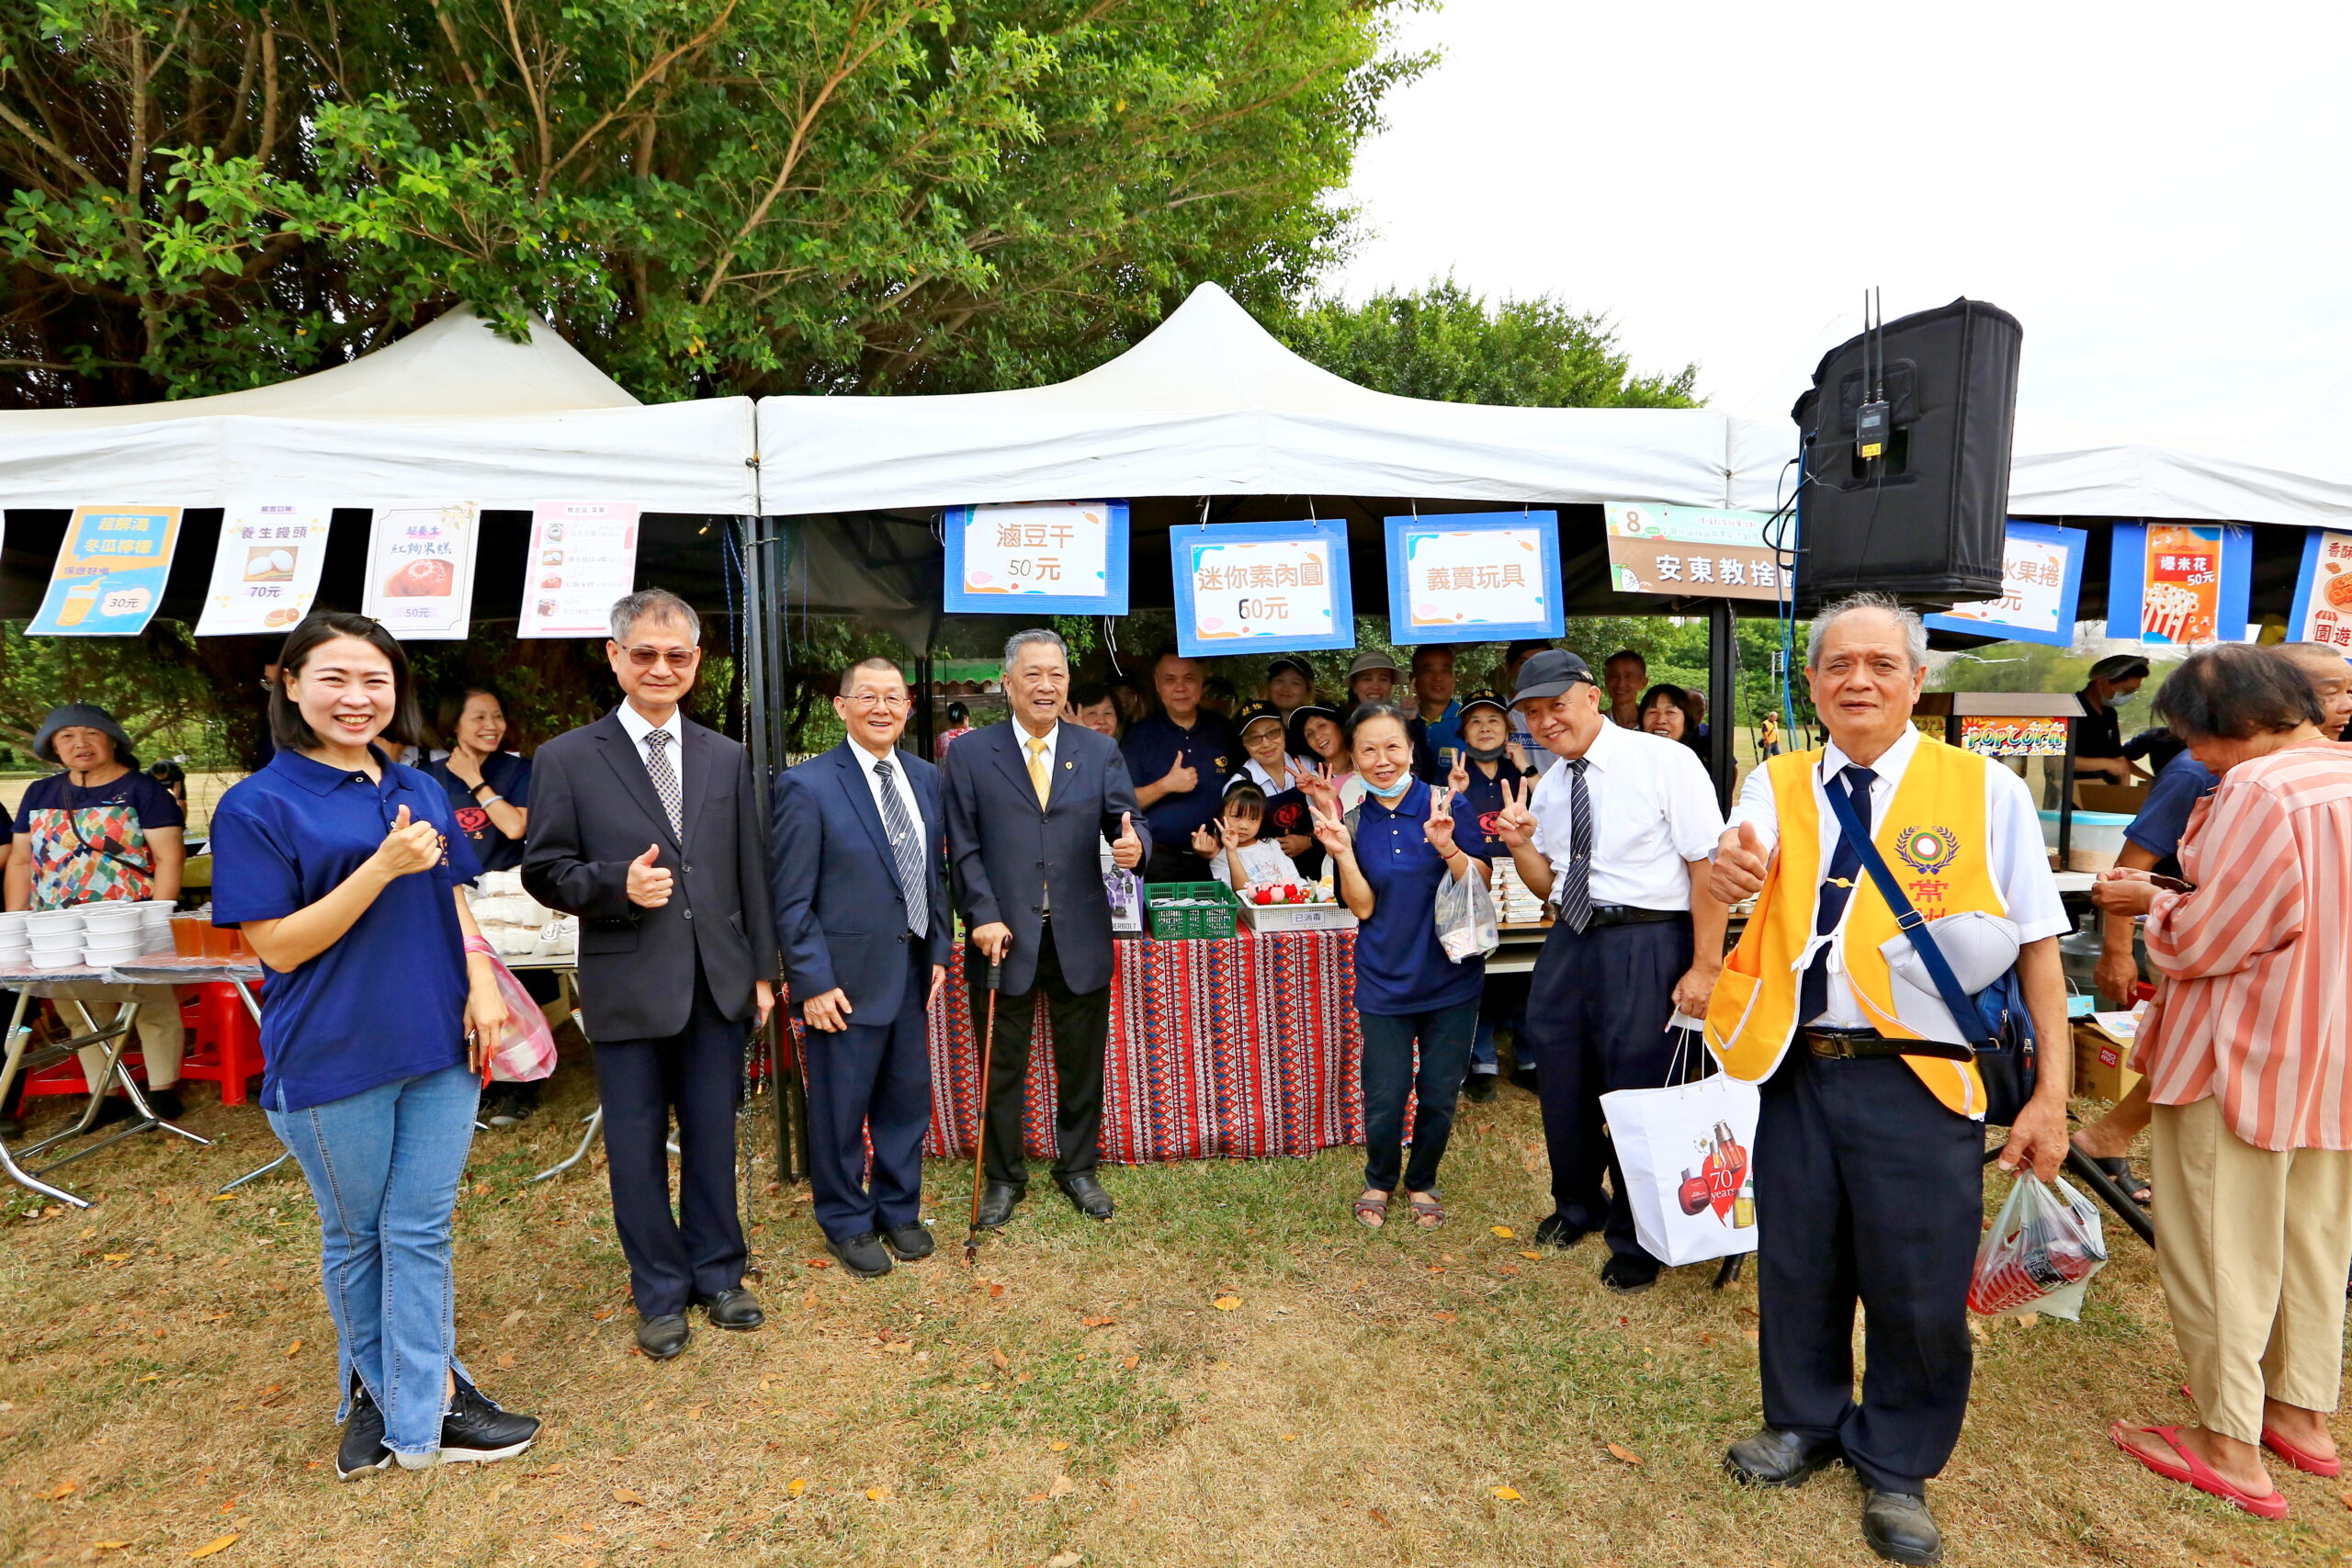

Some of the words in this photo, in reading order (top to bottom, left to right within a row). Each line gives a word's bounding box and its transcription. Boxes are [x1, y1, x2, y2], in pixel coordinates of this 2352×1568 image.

[1626, 511, 1641, 533] 8
[242, 526, 308, 539] 養生饅頭
[997, 523, 1074, 548] 滷豆干
[84, 539, 153, 554] 冬瓜檸檬
[1008, 558, 1061, 581] 50元
[2160, 555, 2207, 571] 爆米花
[1198, 563, 1324, 591] 迷你素肉圓
[1427, 564, 1525, 591] 義賣玩具
[2187, 570, 2215, 586] 50元
[250, 586, 281, 598] 70元
[108, 598, 139, 608] 30元
[1238, 596, 1289, 620] 60元
[404, 607, 429, 618] 50元
[1710, 1169, 1733, 1190] 70
[1711, 1188, 1736, 1202] years
